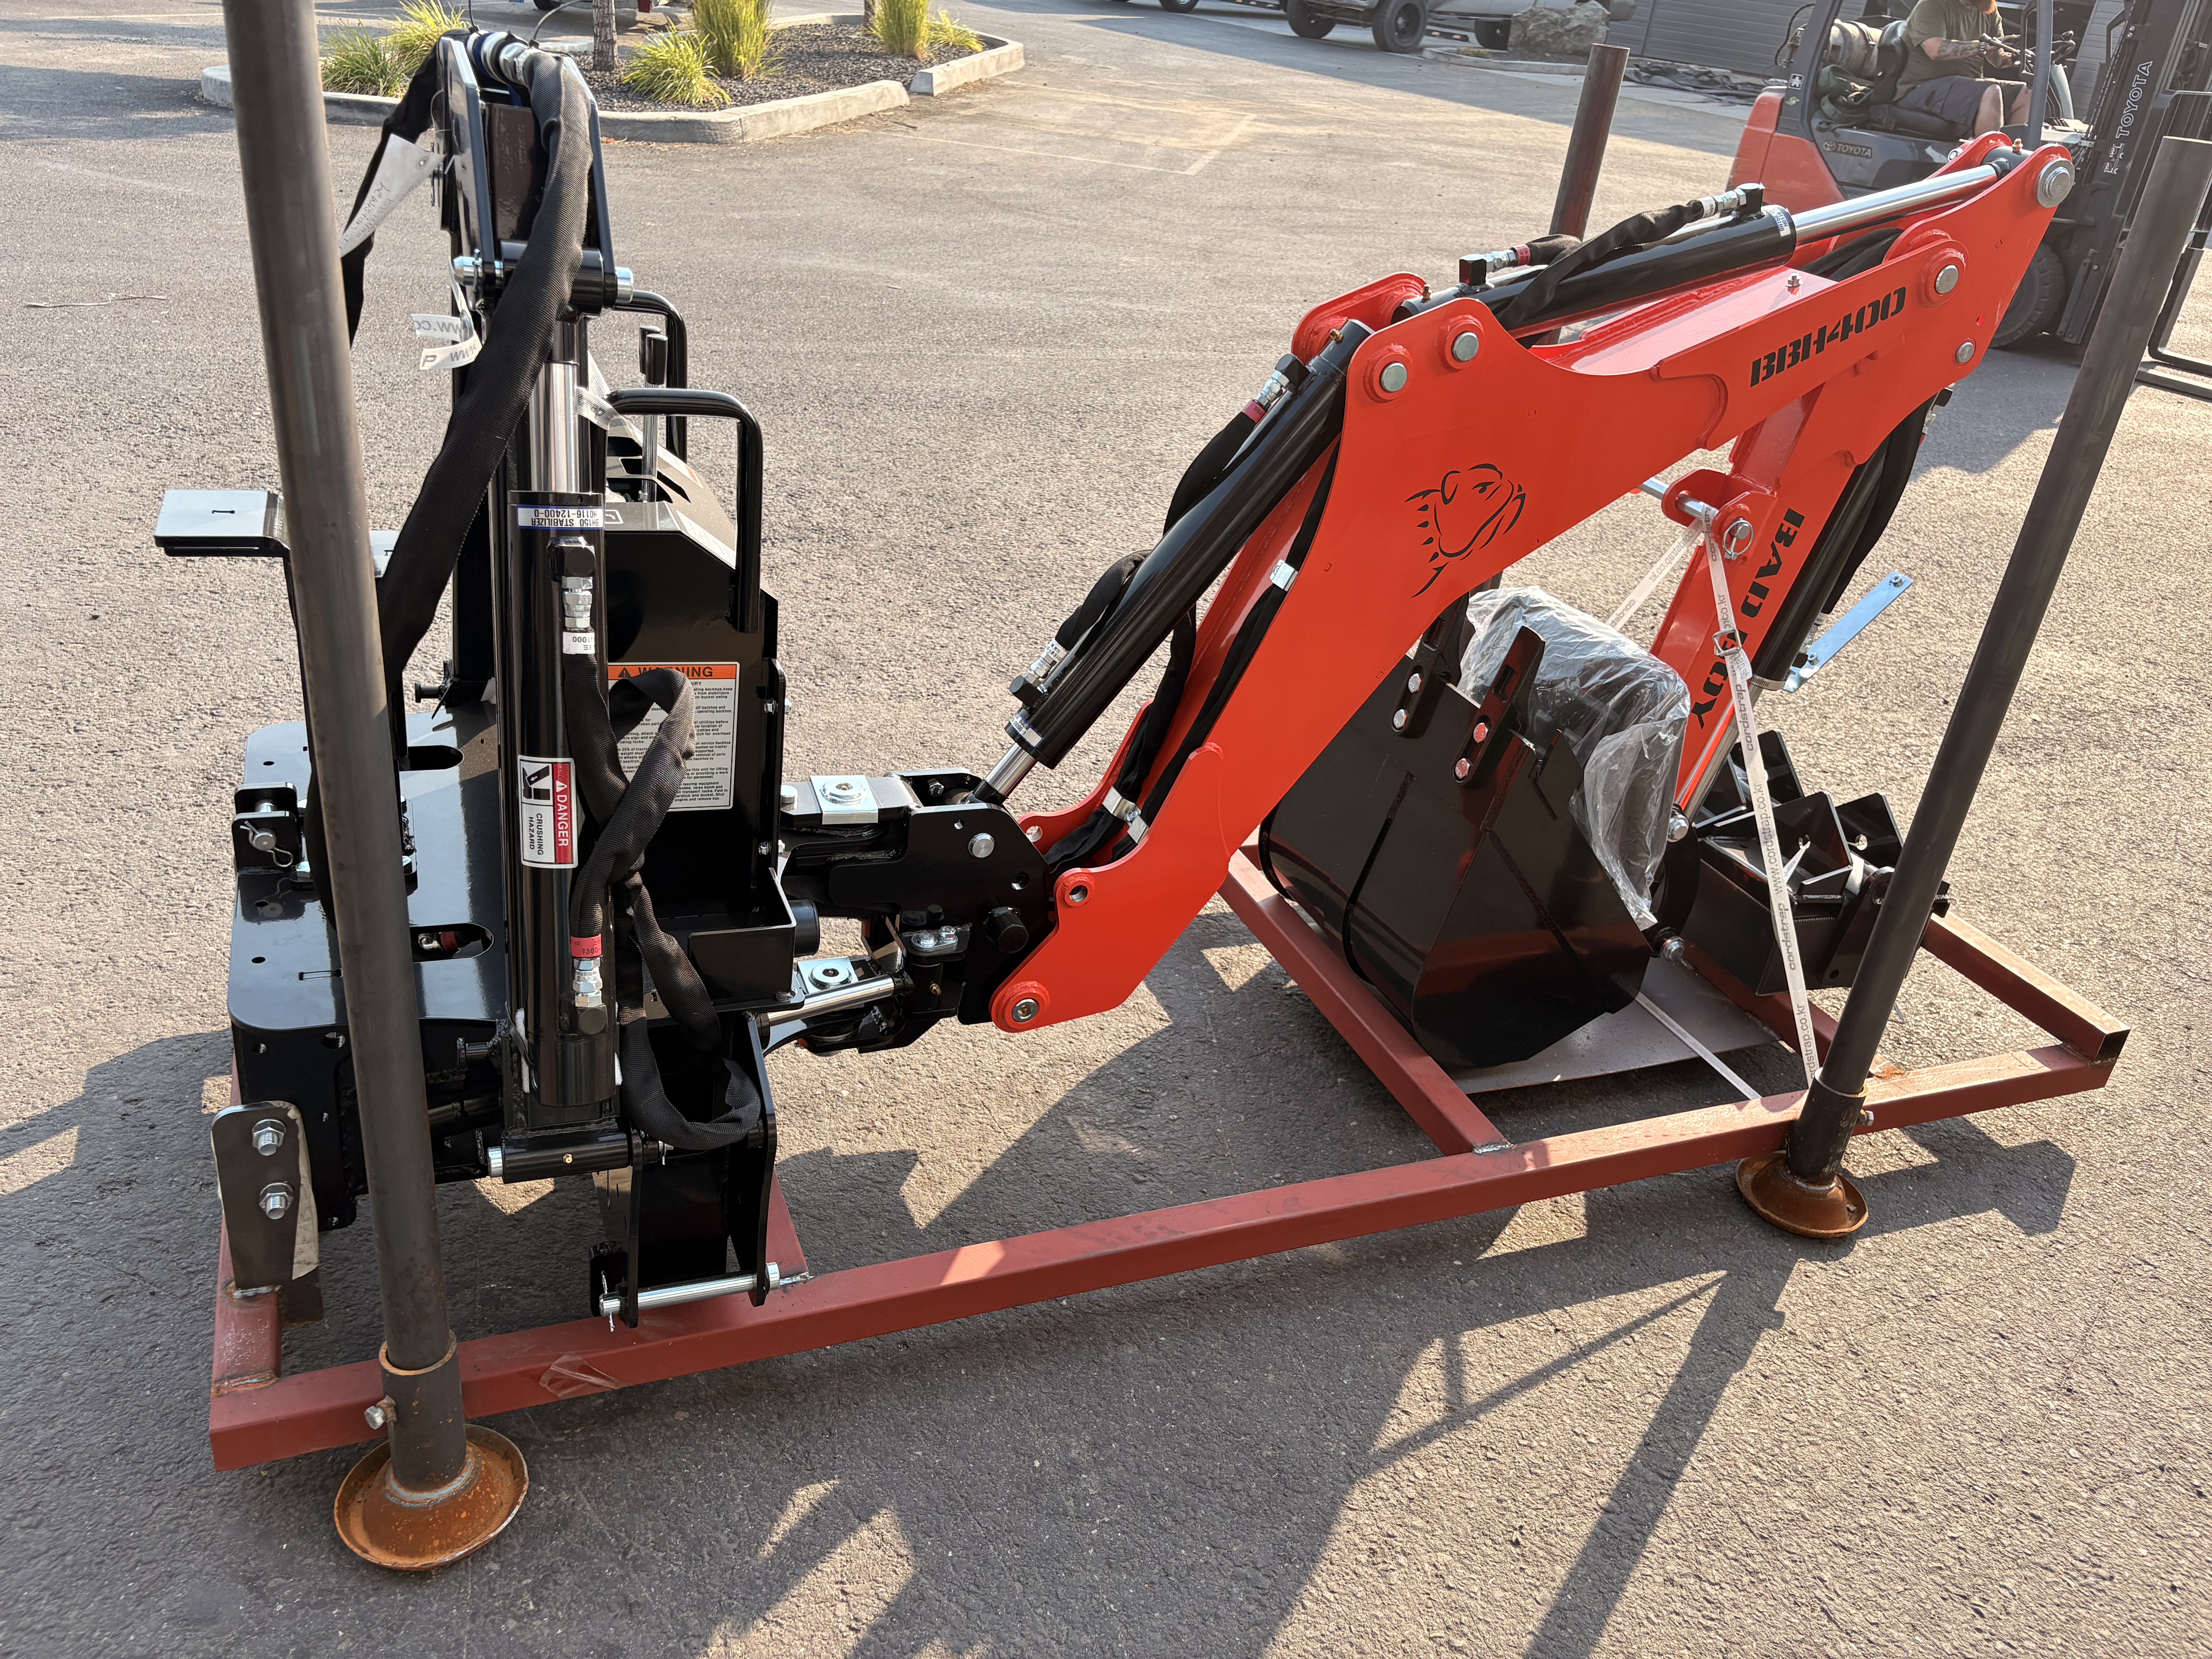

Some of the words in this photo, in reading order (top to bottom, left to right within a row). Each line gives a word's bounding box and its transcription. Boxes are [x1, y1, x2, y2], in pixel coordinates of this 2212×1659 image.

[2116, 61, 2153, 139] TOYOTA
[1837, 144, 1871, 157] TOYOTA
[1750, 286, 1906, 388] BBH400
[531, 518, 574, 527] STABILIZER
[534, 509, 597, 518] H0116-12400-0
[1705, 507, 1717, 562] cordstra
[1741, 508, 1805, 618] BAD
[1736, 684, 1753, 751] cordstrap
[557, 795, 569, 847] DANGER
[1753, 783, 1783, 895] www.cordstrap.co.kr
[1778, 903, 1796, 970] cordstrap
